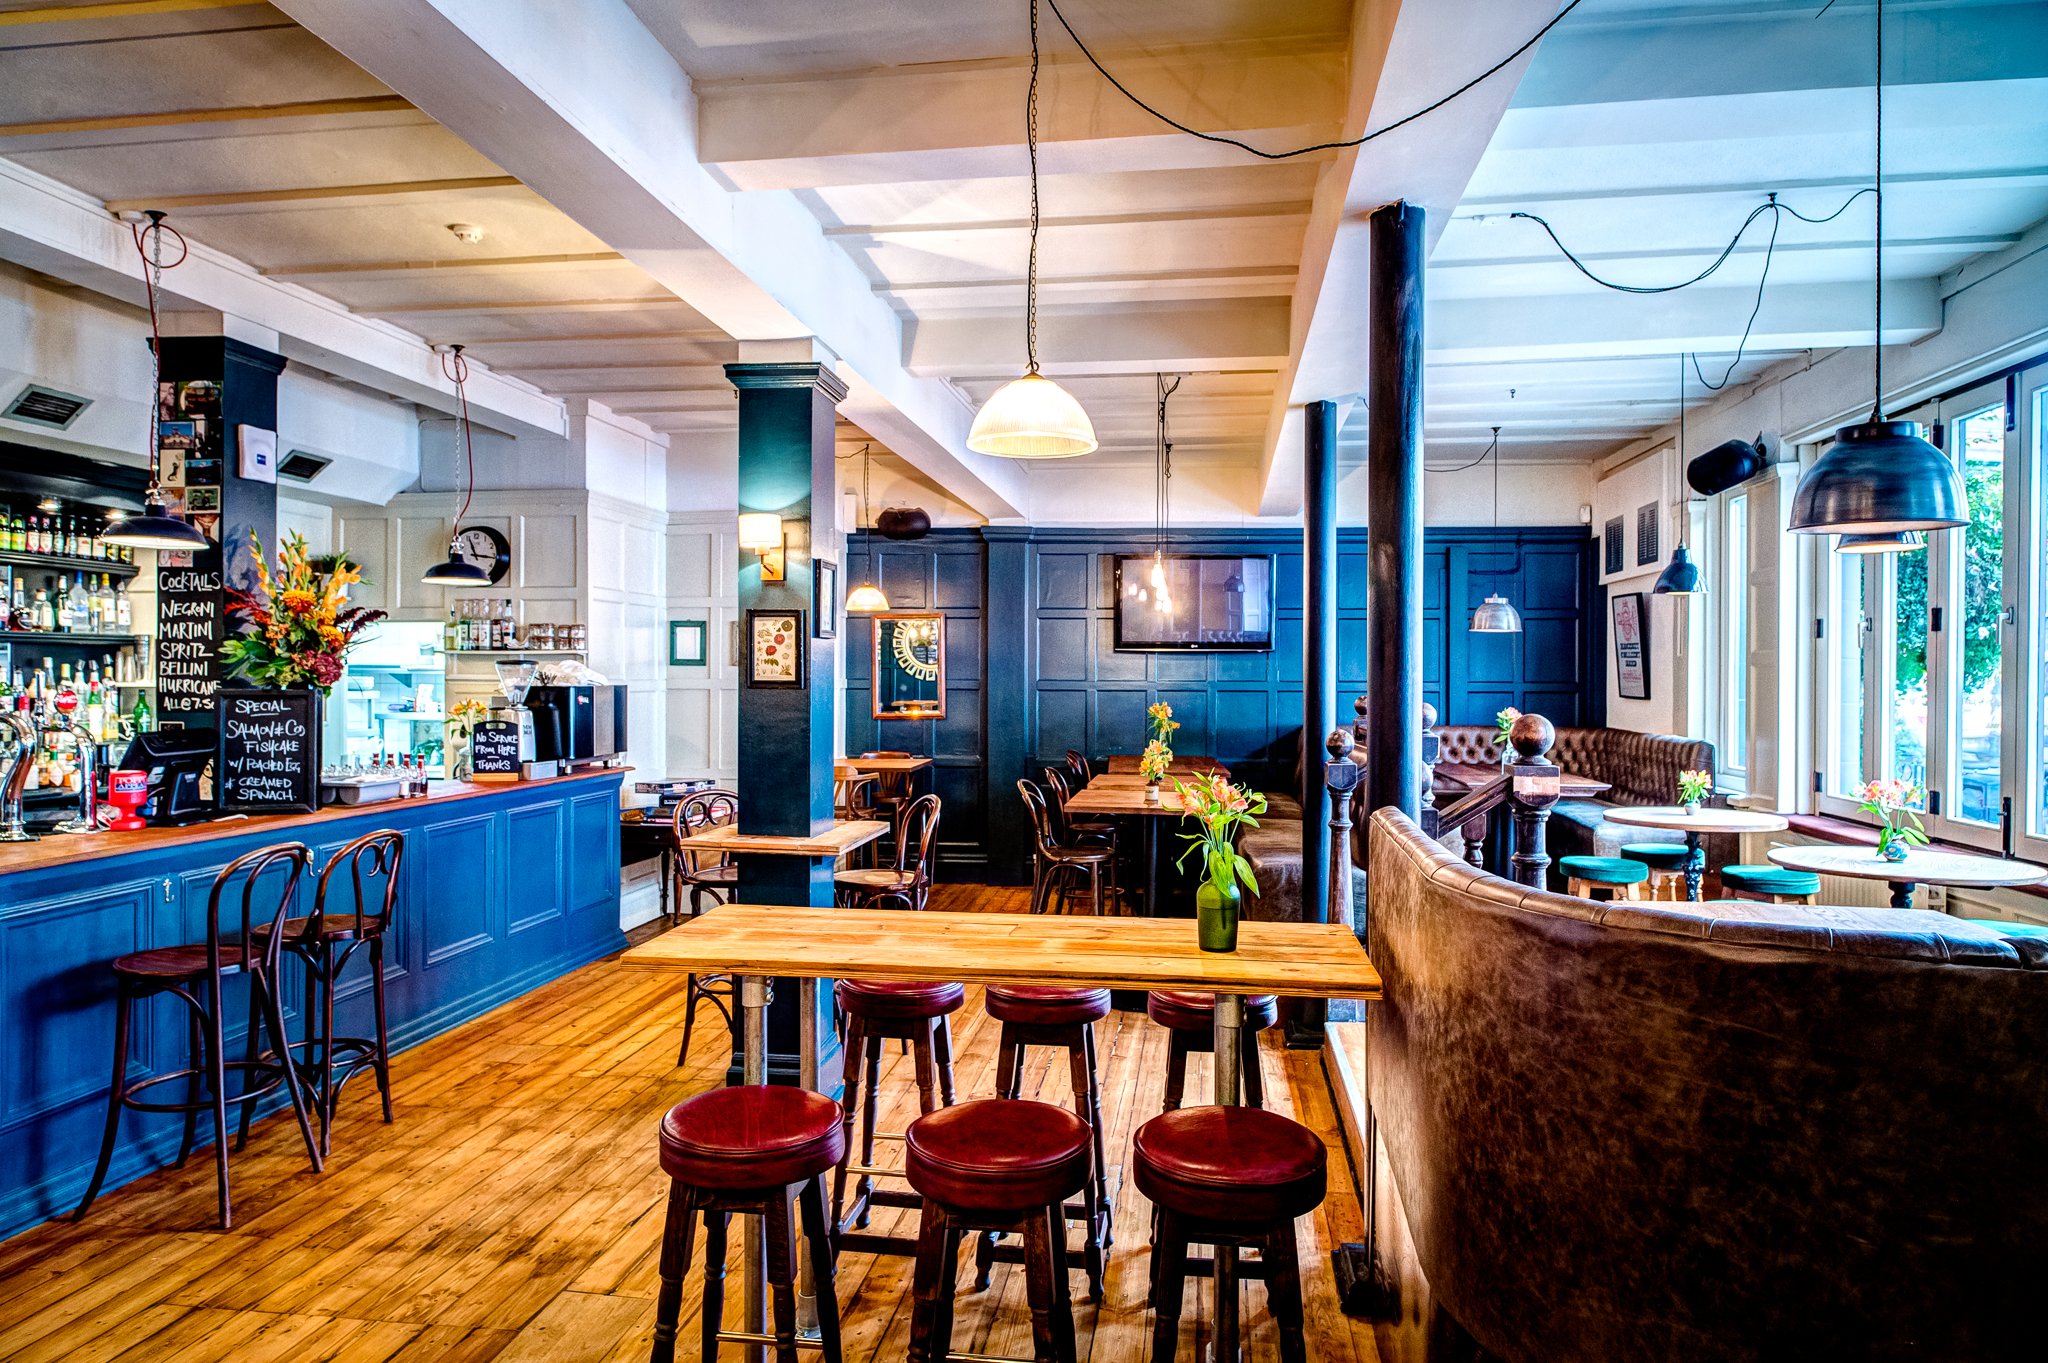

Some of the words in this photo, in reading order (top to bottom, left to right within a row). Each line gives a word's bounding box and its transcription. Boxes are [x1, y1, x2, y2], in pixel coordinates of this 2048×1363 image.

[161, 600, 215, 619] NEGRONI
[159, 620, 213, 640] MARTINI
[160, 642, 214, 660] SPRITZ
[159, 660, 209, 677] BELLINI
[235, 699, 292, 716] SPECIAL
[243, 740, 300, 758] FISHCAKE
[498, 744, 516, 756] HERE
[246, 757, 284, 772] POACHED
[475, 759, 511, 771] THANKS
[238, 776, 292, 790] CREAMED
